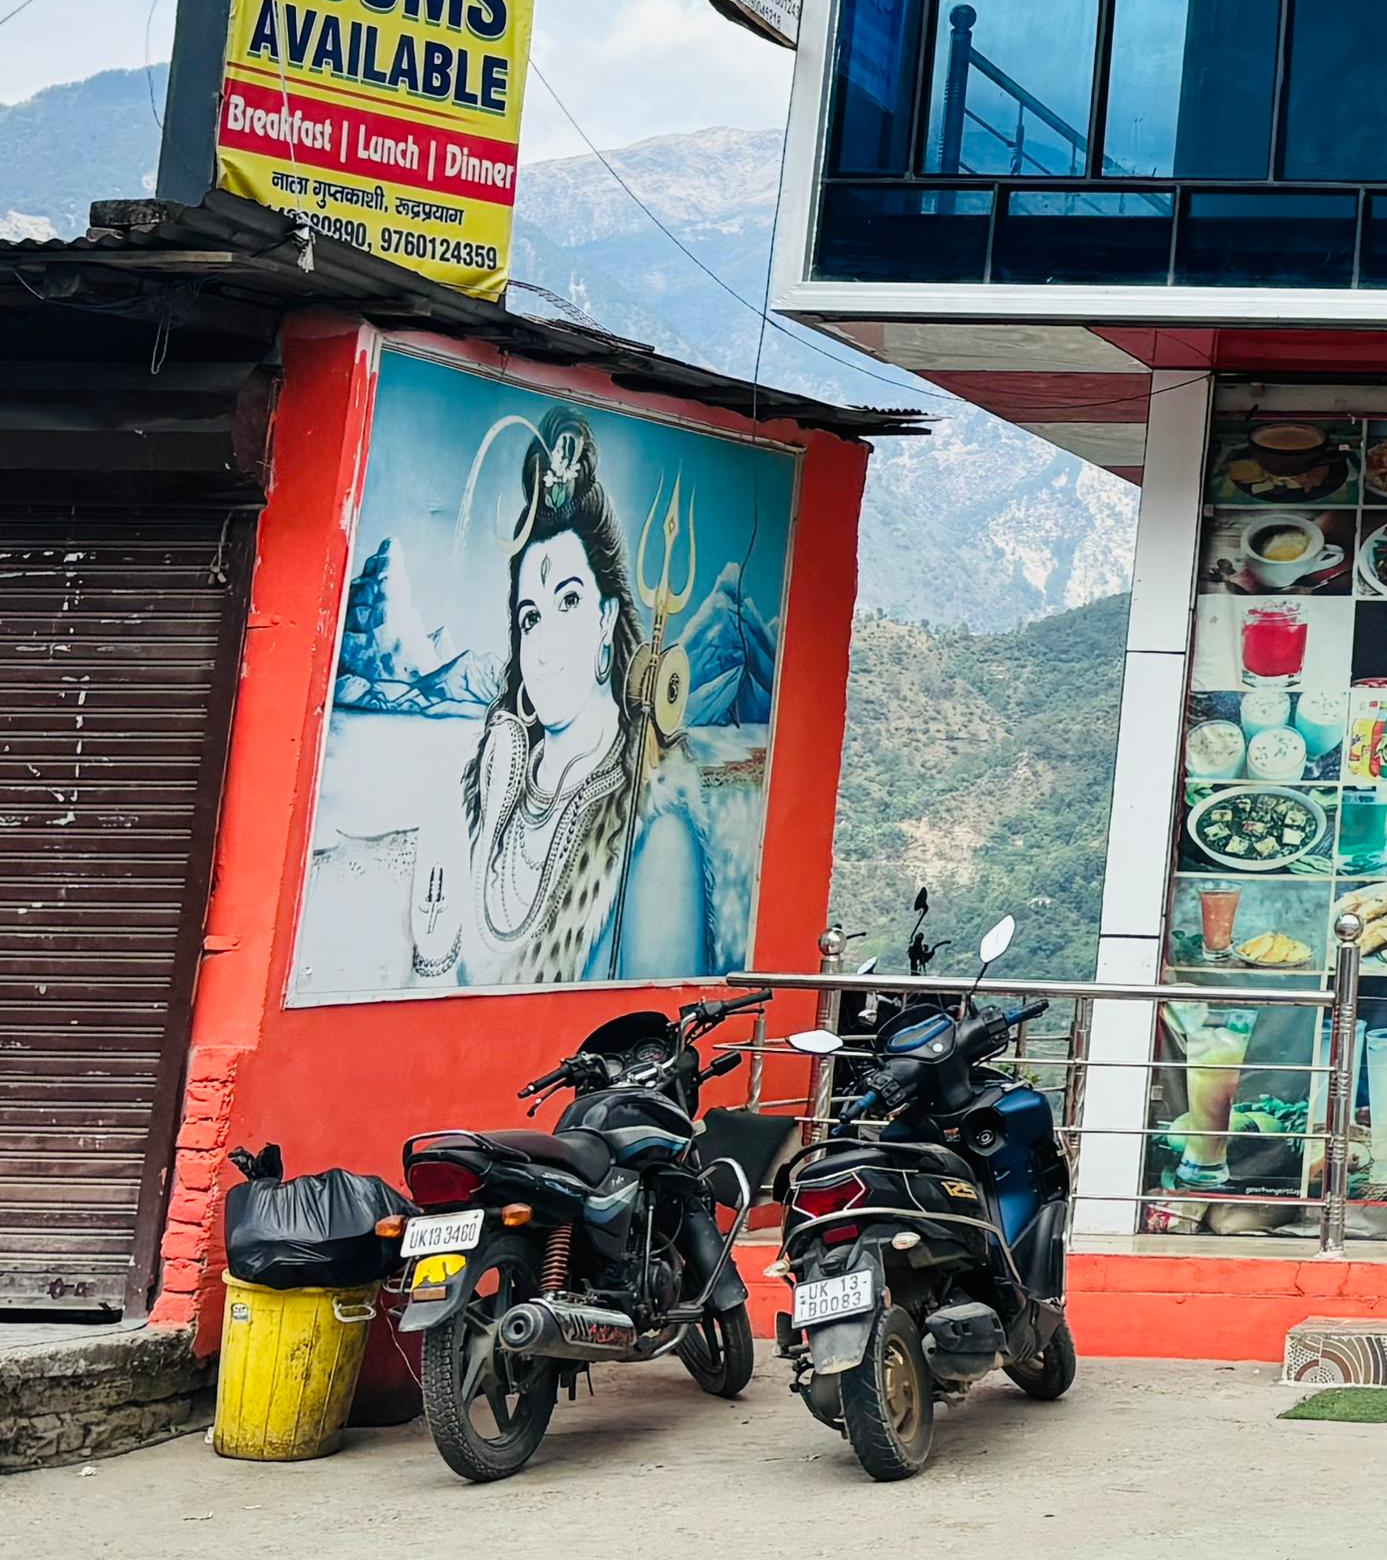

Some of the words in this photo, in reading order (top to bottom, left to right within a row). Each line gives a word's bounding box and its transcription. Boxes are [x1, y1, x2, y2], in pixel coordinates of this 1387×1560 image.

[227, 93, 333, 152] Breakfast
[357, 124, 420, 171] Lunch
[444, 142, 516, 190] Dinner
[271, 170, 311, 196] नाला
[312, 180, 390, 215] गुप्तकाशी,
[380, 226, 497, 272] 9760124359
[808, 1282, 829, 1300] UK
[808, 1291, 862, 1317] B0083
